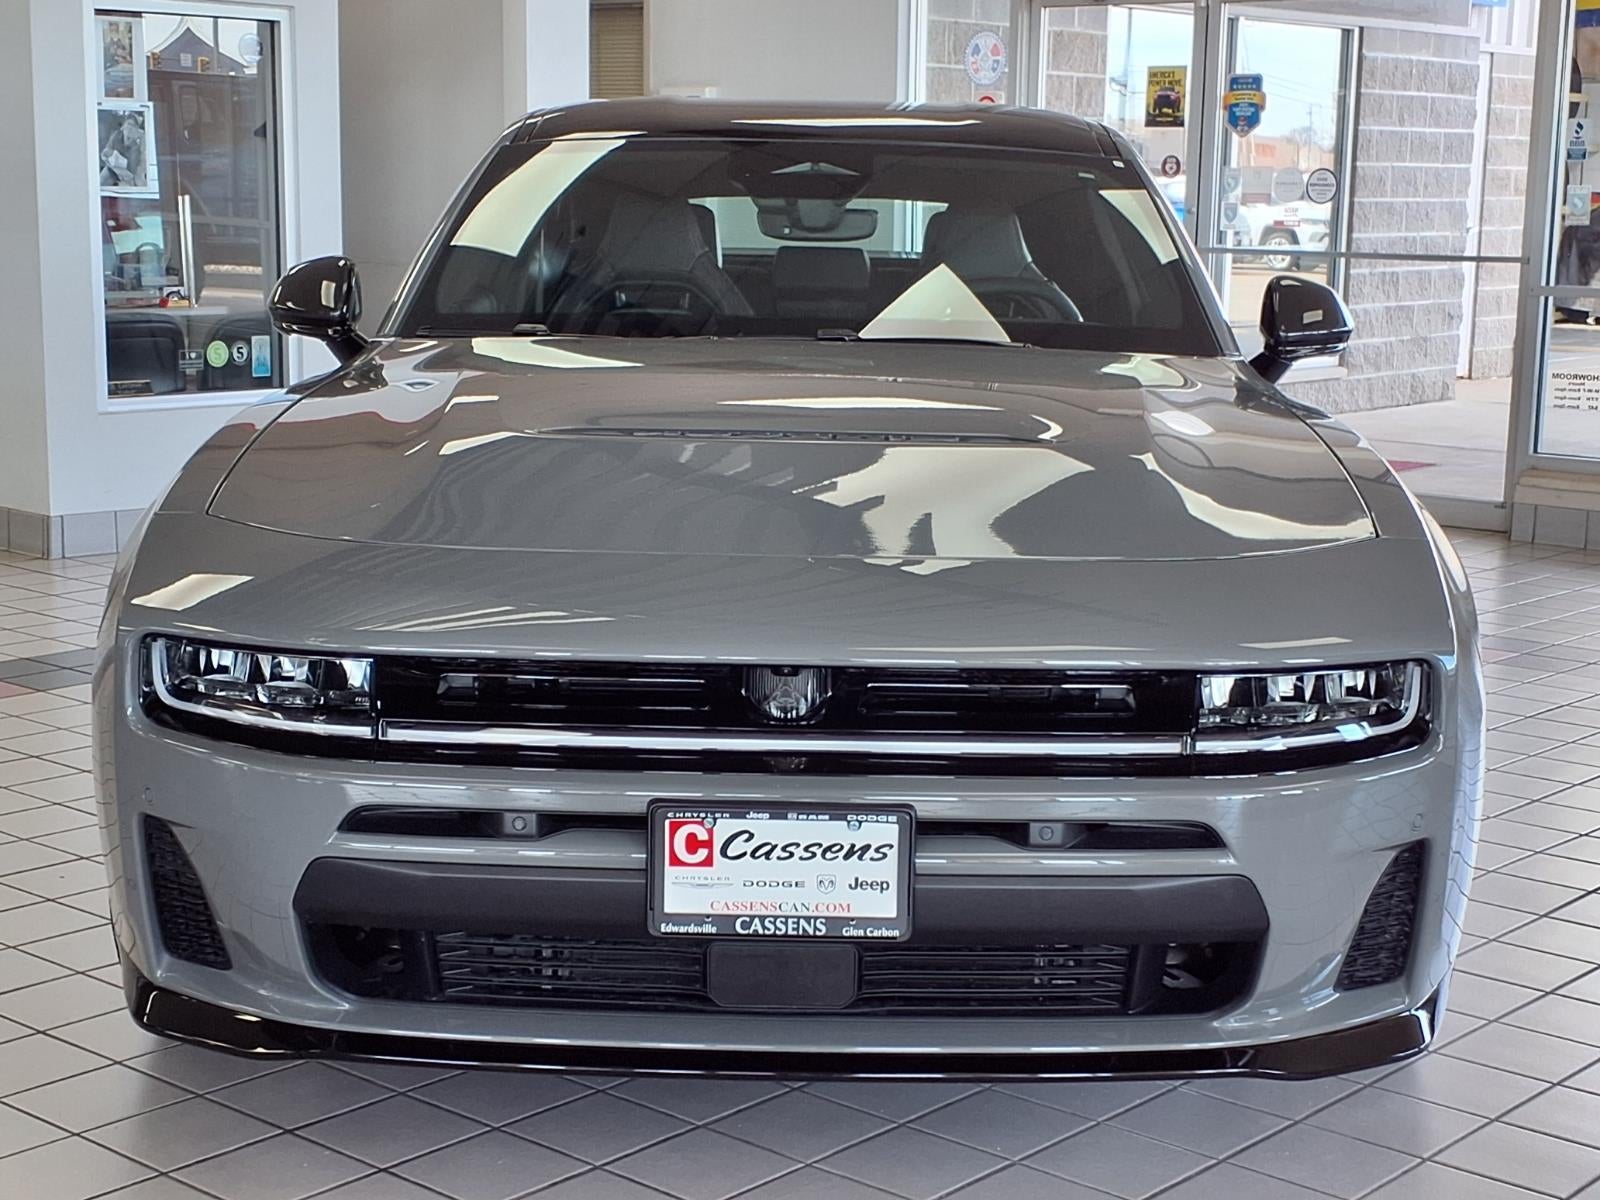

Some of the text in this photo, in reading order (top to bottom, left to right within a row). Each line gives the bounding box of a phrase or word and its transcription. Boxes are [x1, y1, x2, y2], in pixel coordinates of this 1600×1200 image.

[746, 811, 770, 820] Jeep
[847, 814, 898, 822] DODGE
[674, 823, 895, 864] C Cassens
[743, 880, 806, 888] DODGE
[848, 876, 890, 894] Jeep
[710, 901, 852, 913] CASSENSCAN.COM
[660, 917, 900, 938] Edwardsville CASSENS Glen Carbon
